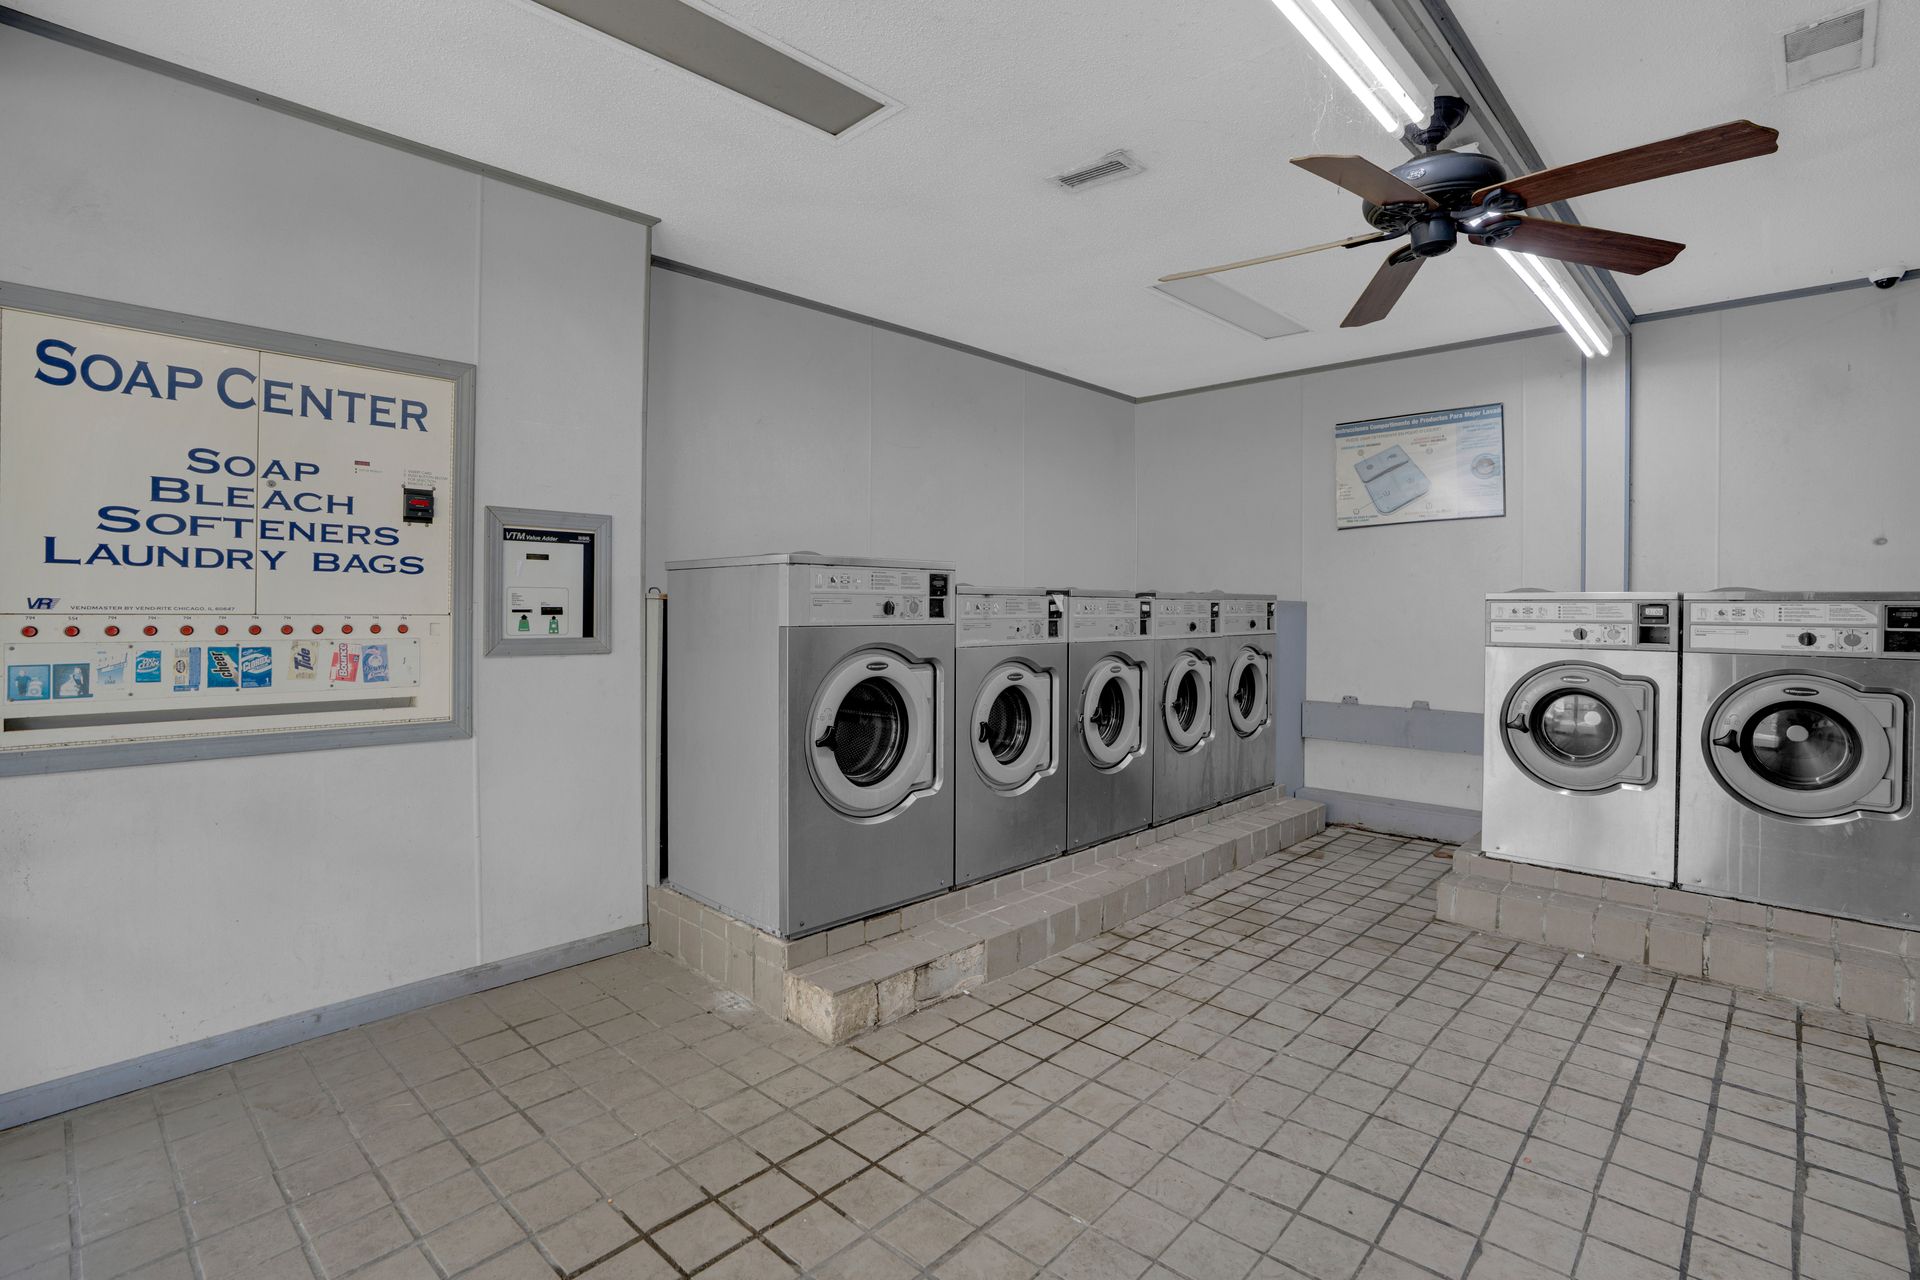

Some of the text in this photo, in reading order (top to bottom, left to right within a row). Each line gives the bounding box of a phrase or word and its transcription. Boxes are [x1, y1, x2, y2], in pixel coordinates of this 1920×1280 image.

[34, 338, 428, 432] SOAP CENTER
[186, 447, 320, 481] SOAP
[150, 475, 354, 515] BLEACH
[96, 505, 400, 545] SOFTENERS
[506, 531, 526, 540] VTM
[44, 536, 425, 575] LAUNDRY BAGS
[293, 647, 314, 671] Tide
[338, 642, 349, 677] Bounce
